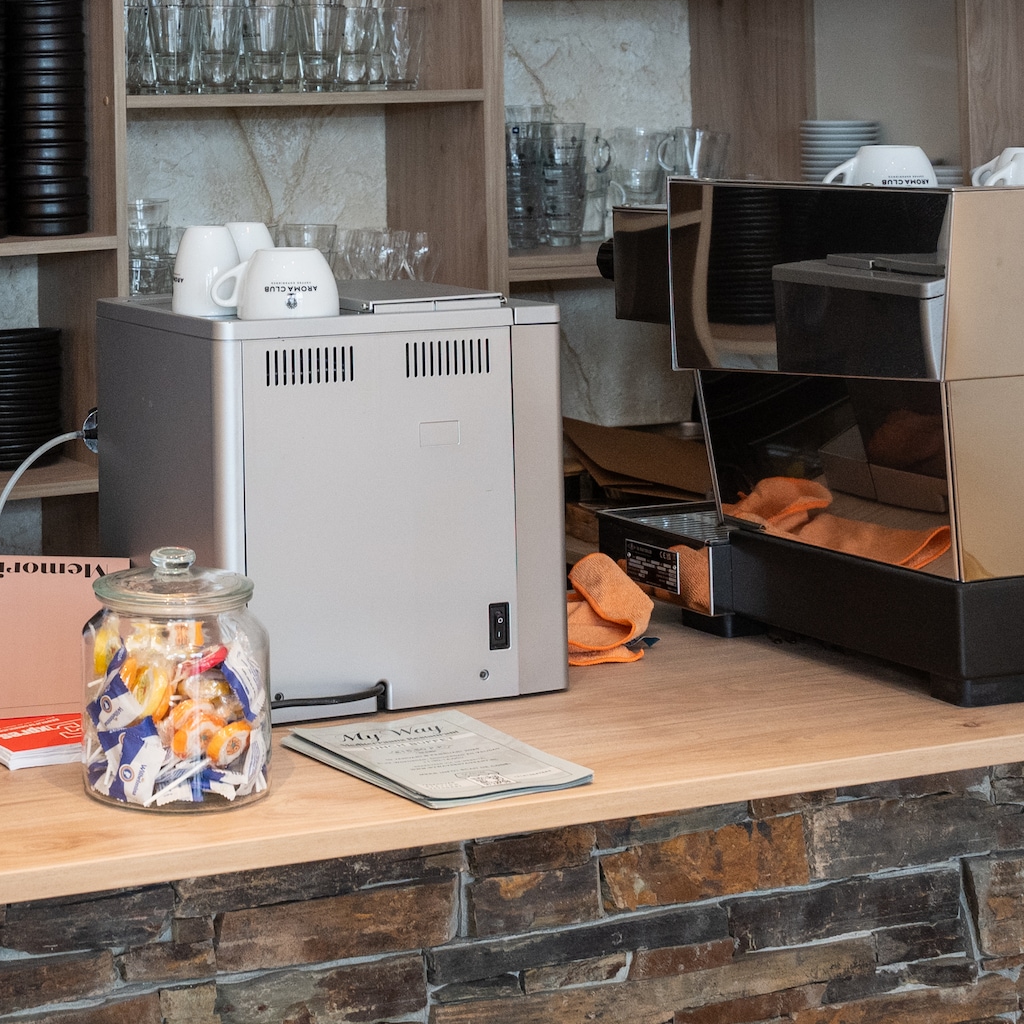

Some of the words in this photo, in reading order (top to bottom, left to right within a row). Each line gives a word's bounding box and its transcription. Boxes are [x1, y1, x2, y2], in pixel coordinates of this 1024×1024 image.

[288, 285, 318, 293] AROMA
[342, 730, 382, 742] My
[388, 725, 444, 737] Way
